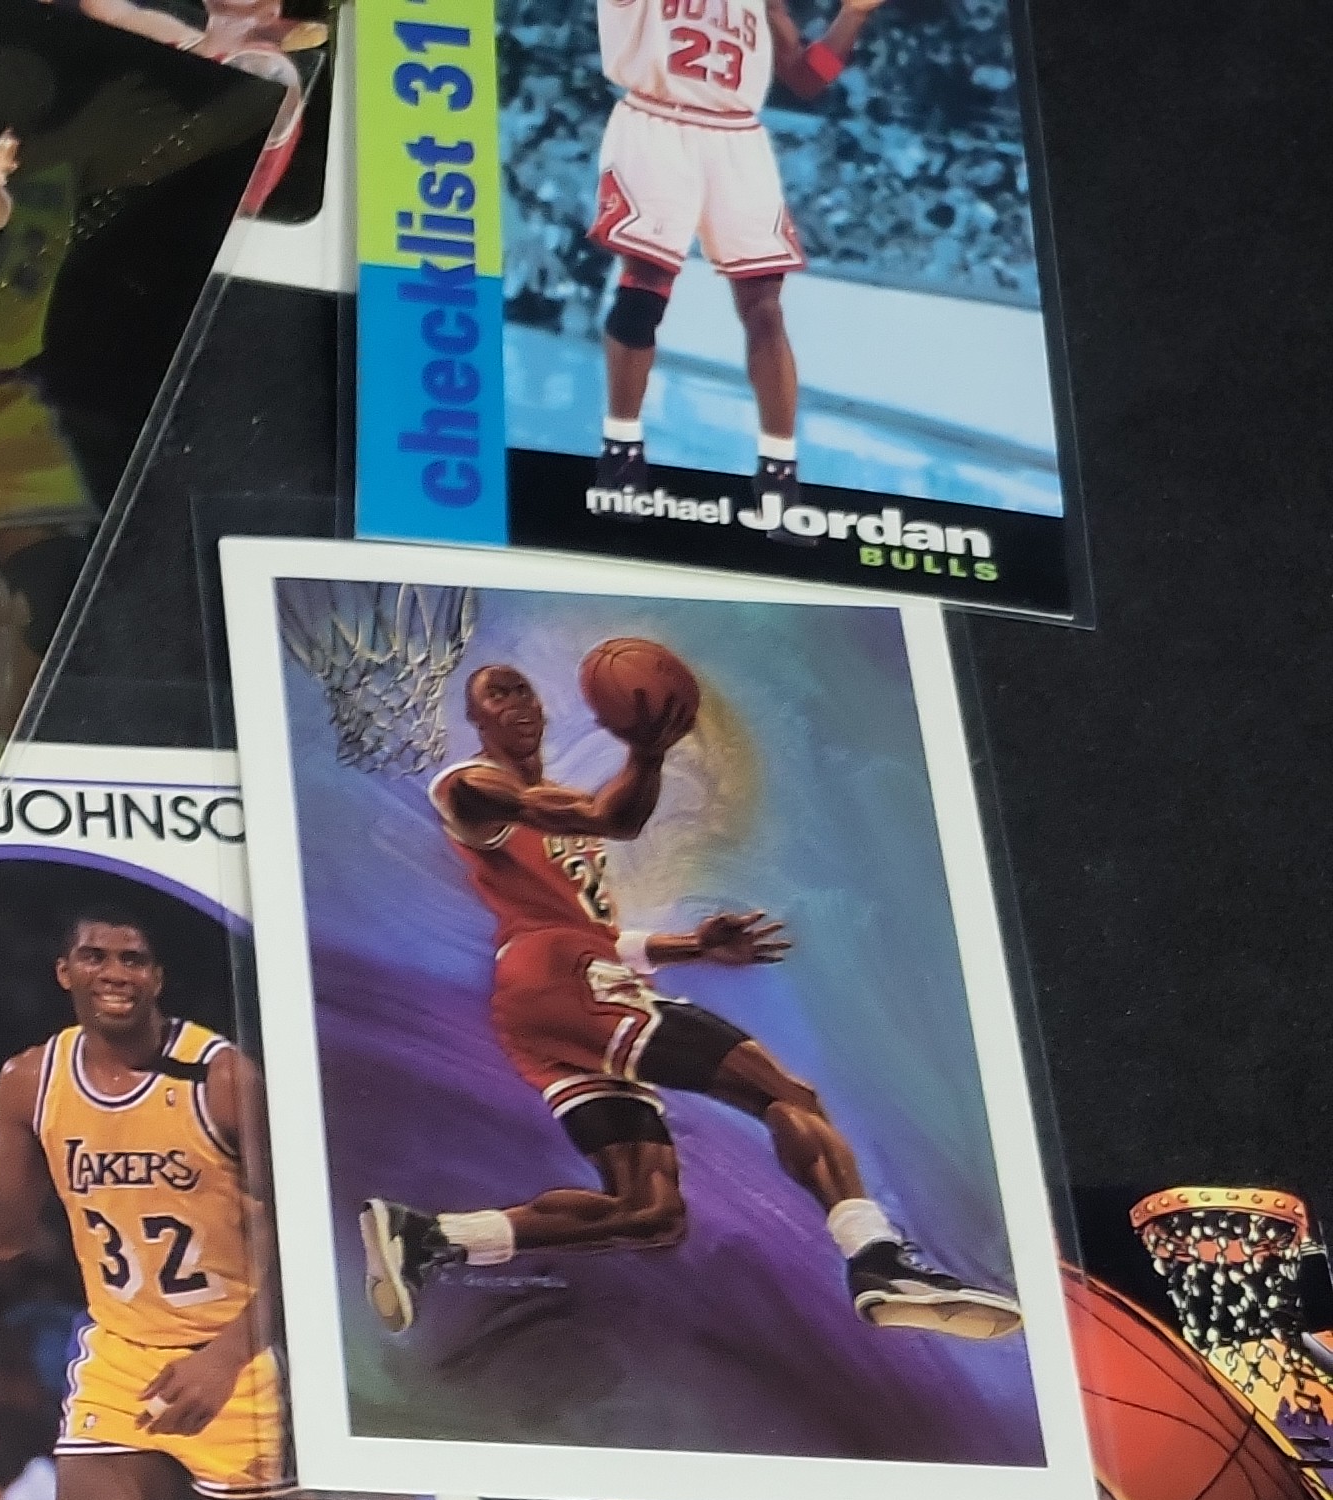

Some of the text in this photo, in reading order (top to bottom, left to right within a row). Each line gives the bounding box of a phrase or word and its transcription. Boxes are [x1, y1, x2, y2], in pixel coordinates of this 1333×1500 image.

[667, 26, 743, 91] 23
[393, 0, 483, 508] checklist 31
[586, 485, 992, 558] michael Jordan
[859, 545, 1000, 582] BULLS
[64, 1138, 201, 1193] LAKERS
[83, 1207, 210, 1301] 32
